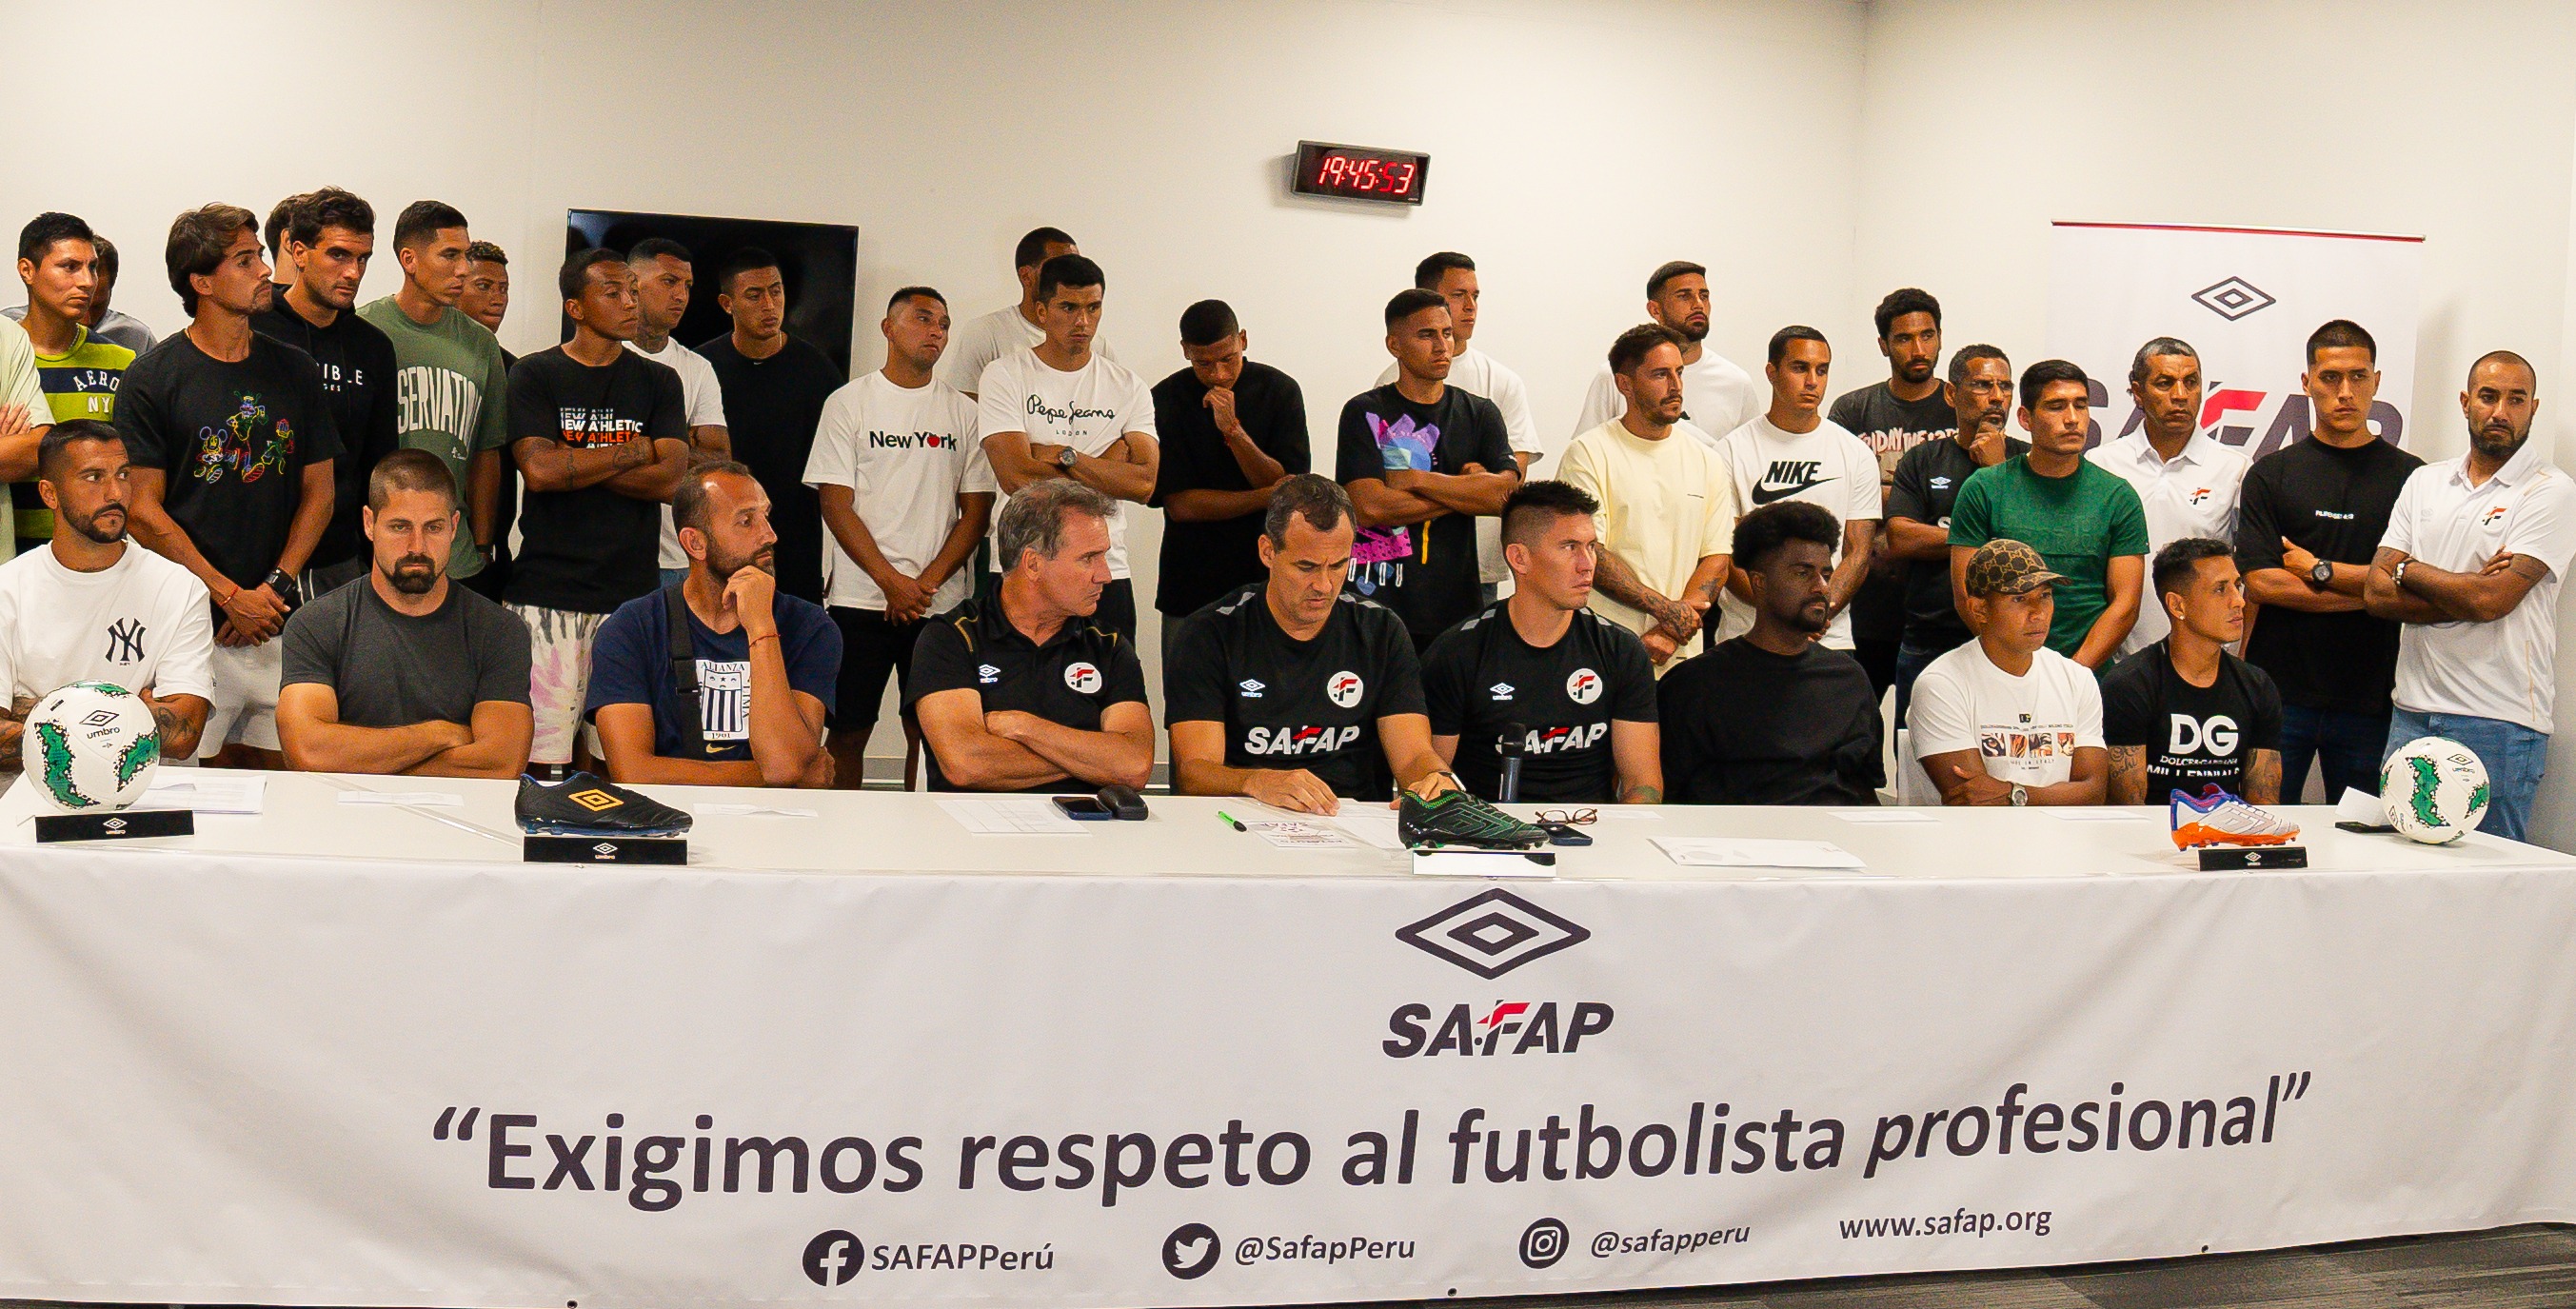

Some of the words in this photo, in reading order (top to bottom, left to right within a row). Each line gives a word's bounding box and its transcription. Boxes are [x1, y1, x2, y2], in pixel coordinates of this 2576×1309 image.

[1318, 156, 1416, 194] 19:45:53
[72, 369, 120, 391] AERO
[88, 395, 111, 413] NY
[1026, 394, 1067, 424] Pepe
[1068, 400, 1116, 425] Jeans
[869, 430, 911, 449] New
[1764, 461, 1822, 484] NIKE
[105, 617, 147, 663] NY
[701, 661, 745, 672] ALIANZA
[86, 725, 121, 740] umbro
[1244, 724, 1360, 755] SAFAP
[2170, 713, 2239, 757] DG
[1382, 1000, 1615, 1058] SAFAP
[433, 1107, 923, 1212] “Exigimos
[959, 1119, 1311, 1207] respeto
[1341, 1109, 1418, 1186] al
[1449, 1102, 1845, 1184] futbolista
[1863, 1071, 2311, 1180] profesional”
[1839, 1207, 2052, 1240] www.safap.org
[1235, 1235, 1416, 1265] @SafapPeru
[1591, 1223, 1751, 1259] @safapperu
[871, 1243, 1054, 1271] SAFAPPerú
